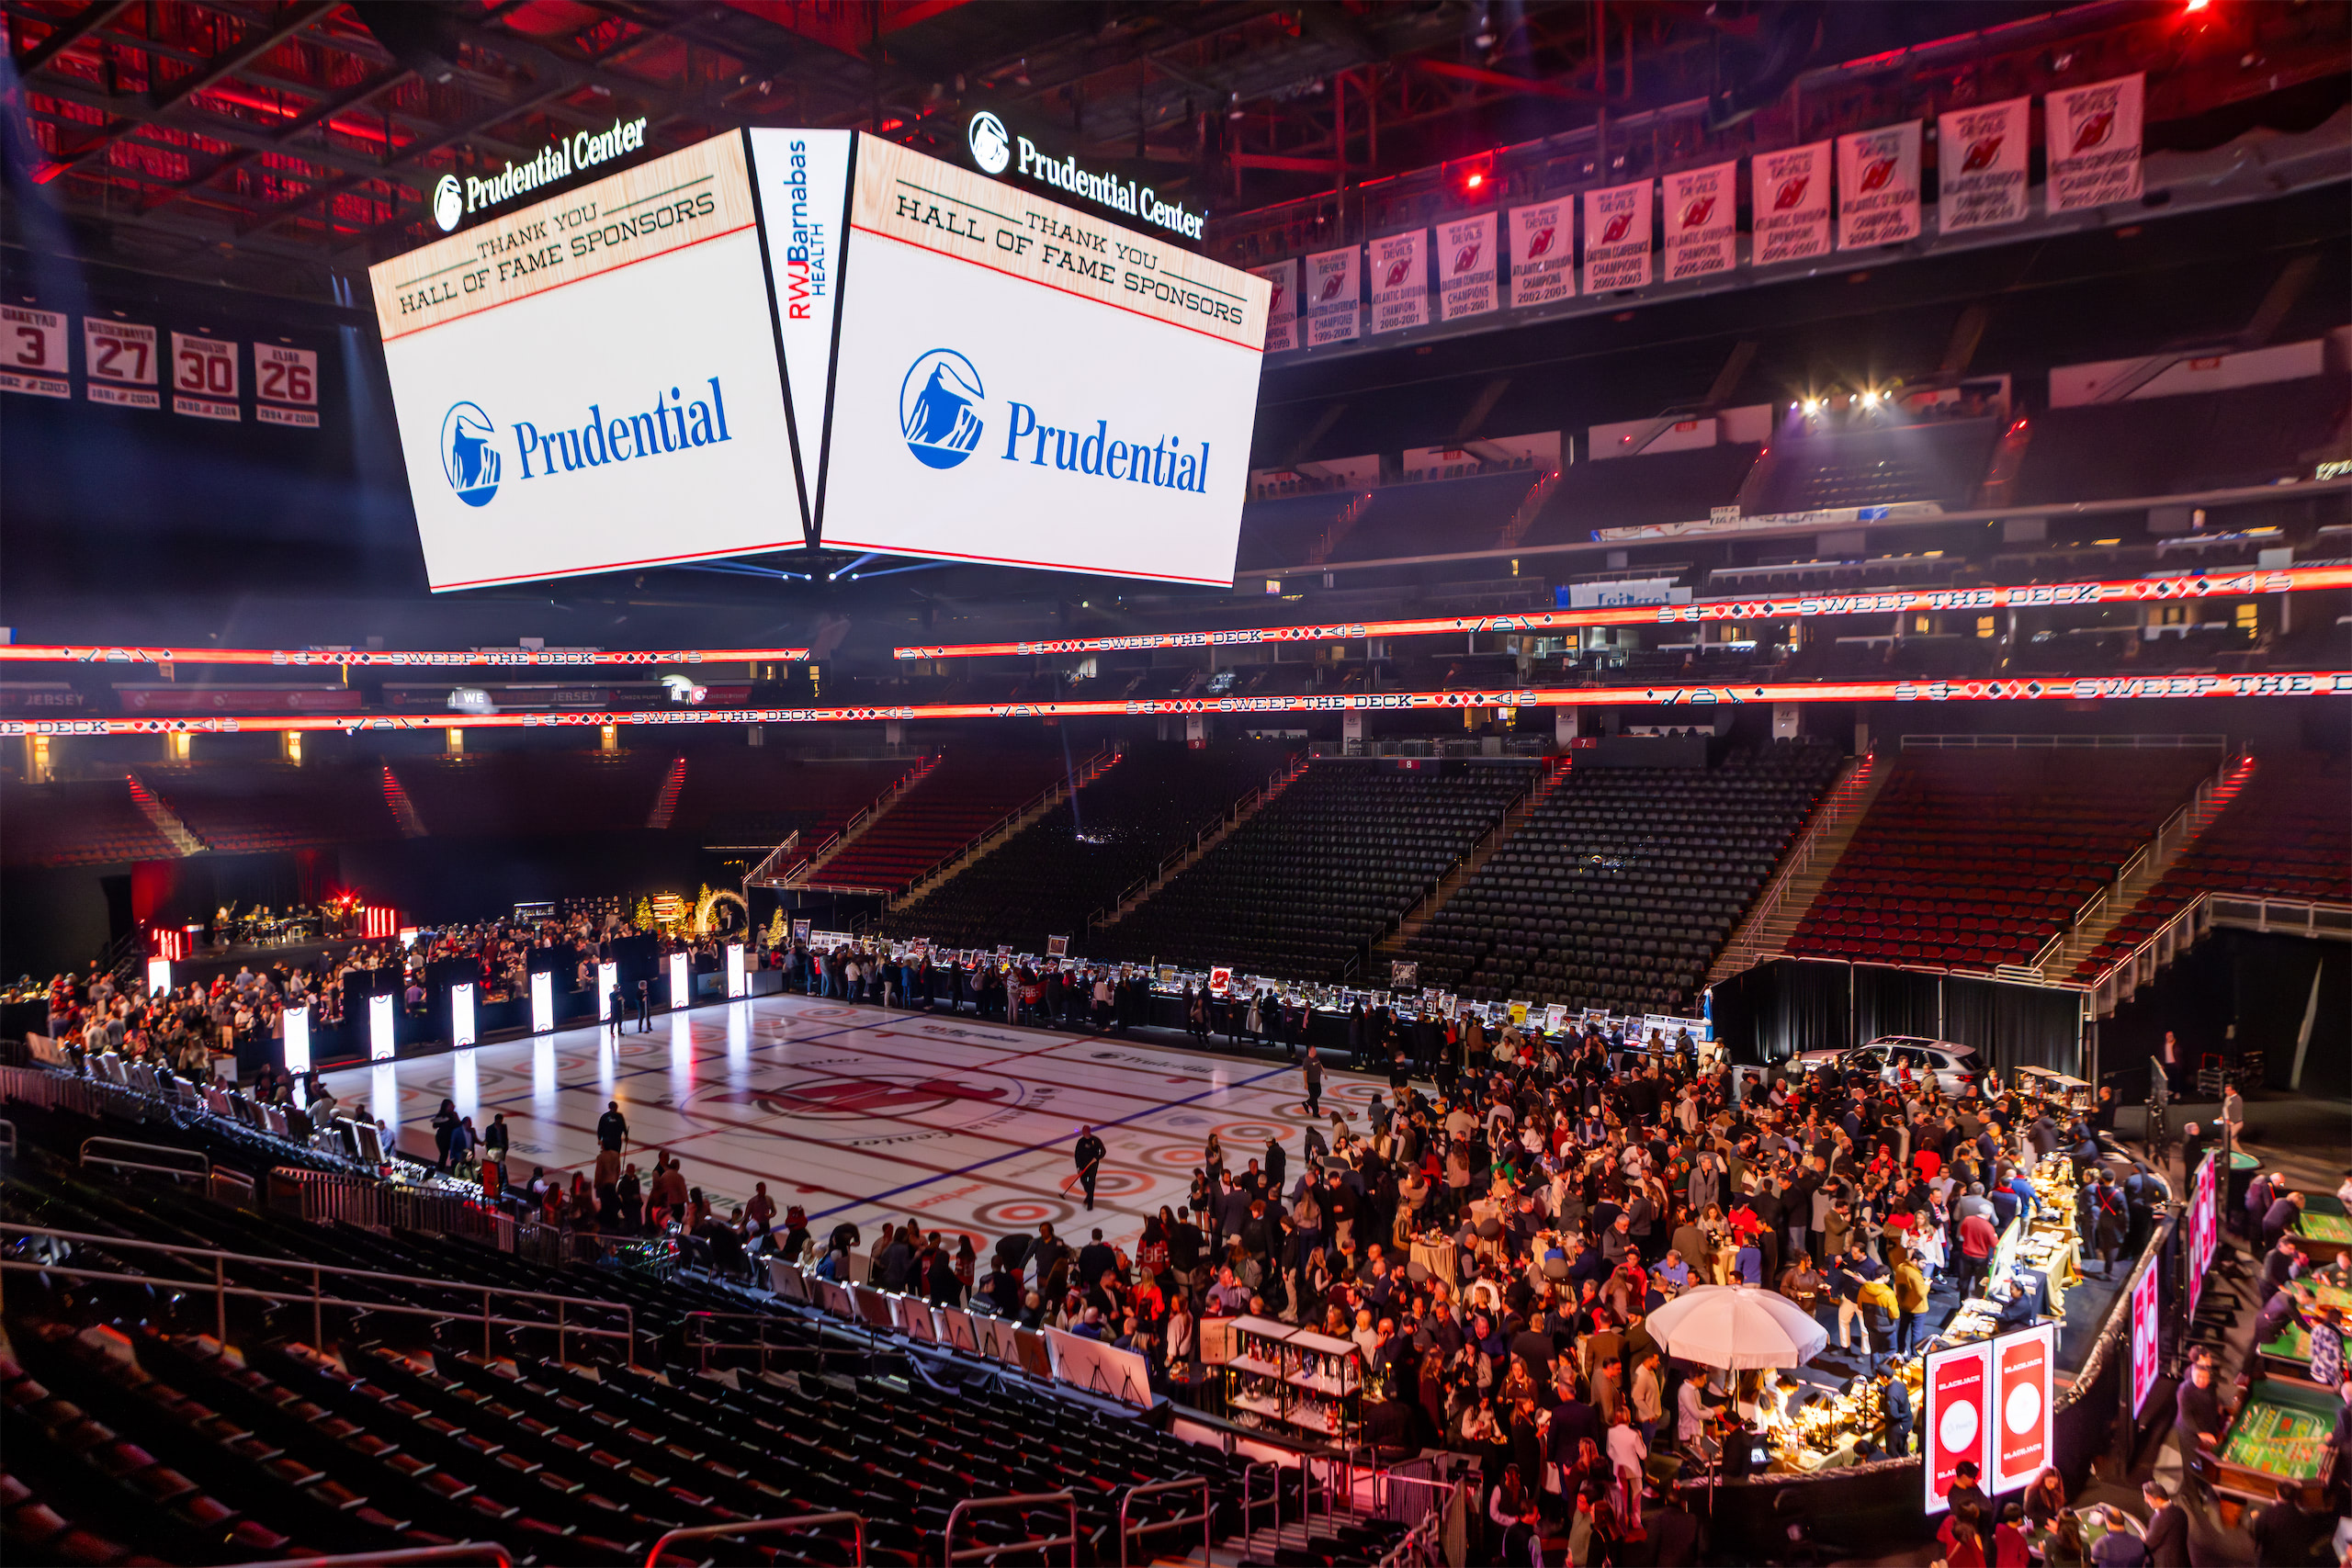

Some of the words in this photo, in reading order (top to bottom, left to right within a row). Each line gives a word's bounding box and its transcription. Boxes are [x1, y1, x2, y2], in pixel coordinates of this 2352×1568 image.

[466, 137, 571, 213] Prudential
[573, 117, 647, 170] Center
[1017, 135, 1137, 216] Prudential
[1139, 186, 1204, 241] Center
[788, 139, 811, 320] RWJBarnabas
[1525, 212, 1557, 230] DEVILS
[477, 220, 548, 260] THANK
[553, 202, 597, 232] YOU
[1452, 228, 1482, 245] DEVILS
[1025, 211, 1106, 254] THANK
[1115, 243, 1158, 271] YOU
[401, 281, 458, 314] HALL
[462, 268, 490, 295] OF
[498, 244, 563, 282] FAME
[572, 193, 715, 257] SPONSORS
[812, 223, 826, 296] HEALTH
[897, 195, 985, 243] HALL
[996, 229, 1033, 255] OF
[1043, 245, 1114, 284] FAME
[1124, 272, 1243, 325] SPONSORS
[1384, 244, 1413, 260] DEVILS
[1319, 261, 1346, 275] DEVILS
[1522, 272, 1561, 289] CHAMPIONS
[1373, 290, 1399, 305] ATLANTIC
[1447, 286, 1489, 305] CHAMPIONS
[1518, 286, 1567, 303] 2002-2003
[1382, 301, 1417, 317] CHAMPIONS
[1315, 314, 1352, 331] CHAMPIONS
[1380, 314, 1419, 330] 2000-2001
[1314, 329, 1351, 342] 1999-2000
[17, 327, 45, 366] 3
[95, 337, 148, 379] 27
[179, 351, 232, 393] 30
[262, 360, 311, 401] 26
[511, 376, 732, 479] Prudential
[1001, 400, 1210, 494] Prudential
[1800, 595, 1917, 615] SWEEP
[1928, 589, 1995, 610] THE
[2006, 582, 2102, 605] DECK
[1099, 635, 1164, 651] SWEEP
[1170, 632, 1206, 647] THE
[1213, 629, 1262, 644] DECK
[390, 652, 477, 665] SWEEP
[483, 652, 530, 665] THE
[537, 652, 595, 665] DECK
[2074, 678, 2220, 697] SWEEP
[2231, 673, 2315, 695] THE
[25, 694, 84, 706] JERSEY
[463, 693, 484, 704] WE
[550, 692, 597, 703] JERSEY
[1220, 697, 1296, 711] SWEEP
[1303, 695, 1346, 710] THE
[1353, 694, 1413, 708] DECK
[631, 712, 710, 724] SWEEP
[718, 711, 759, 724] THE
[765, 709, 819, 722] DECK
[37, 721, 108, 734] DECK
[1194, 740, 1200, 749] 9
[1580, 739, 1587, 748] 7
[1426, 1002, 1437, 1013] 91
[1124, 1055, 1214, 1073] Prudential
[850, 1131, 954, 1146] Center
[1144, 1247, 1164, 1263] 86
[2004, 1358, 2042, 1373] BLACKJACK
[1939, 1375, 1980, 1391] BLACKJACK
[2004, 1443, 2042, 1461] BLACKJACK
